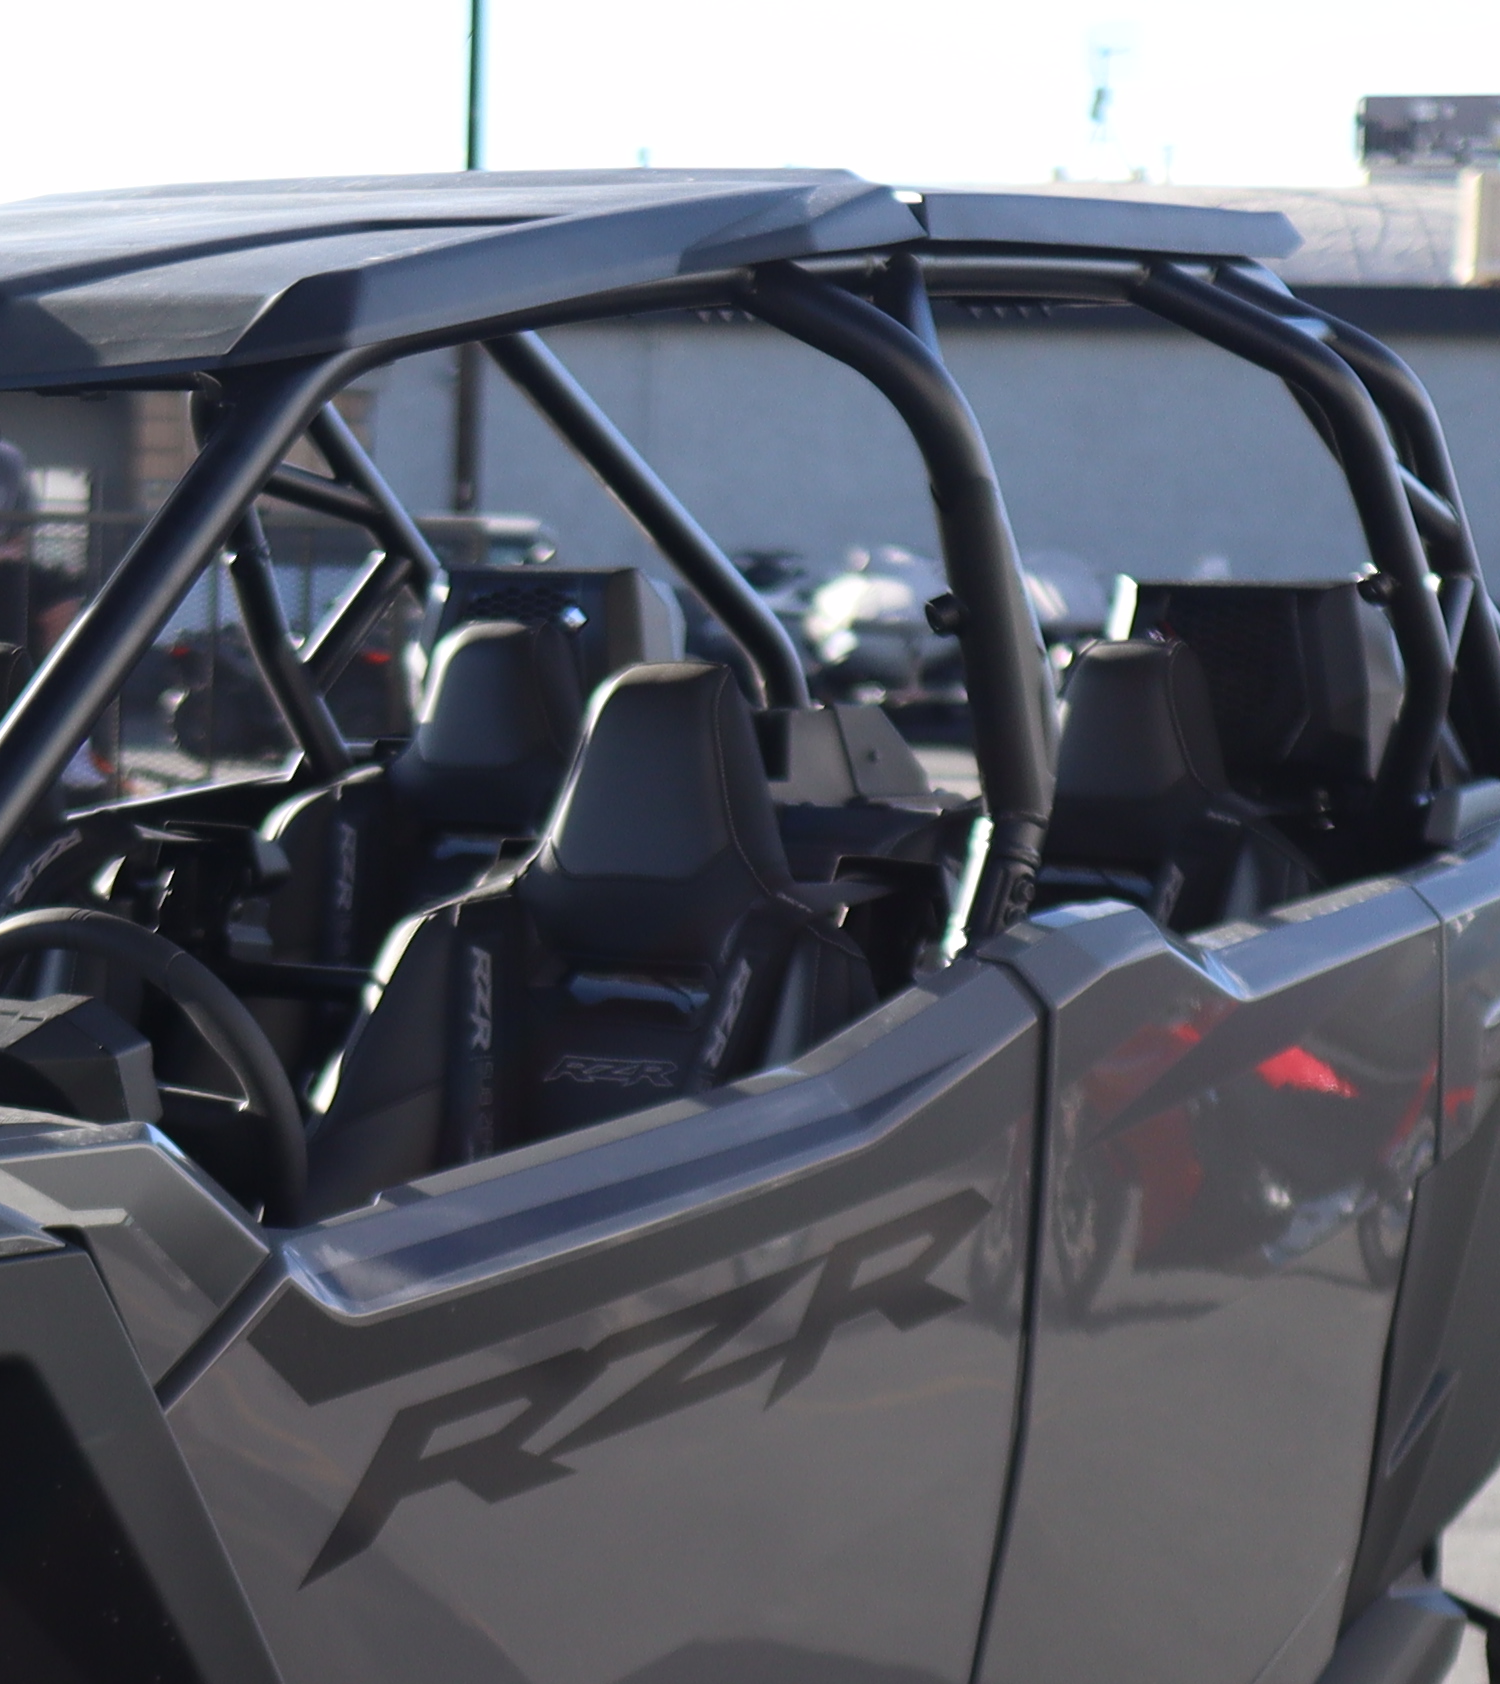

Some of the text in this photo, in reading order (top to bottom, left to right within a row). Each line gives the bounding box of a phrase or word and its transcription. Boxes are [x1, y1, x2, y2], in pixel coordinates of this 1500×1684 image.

[470, 945, 493, 1051] RZR
[703, 959, 753, 1069] RZR
[543, 1055, 680, 1088] RZR
[297, 1186, 995, 1592] RZR
